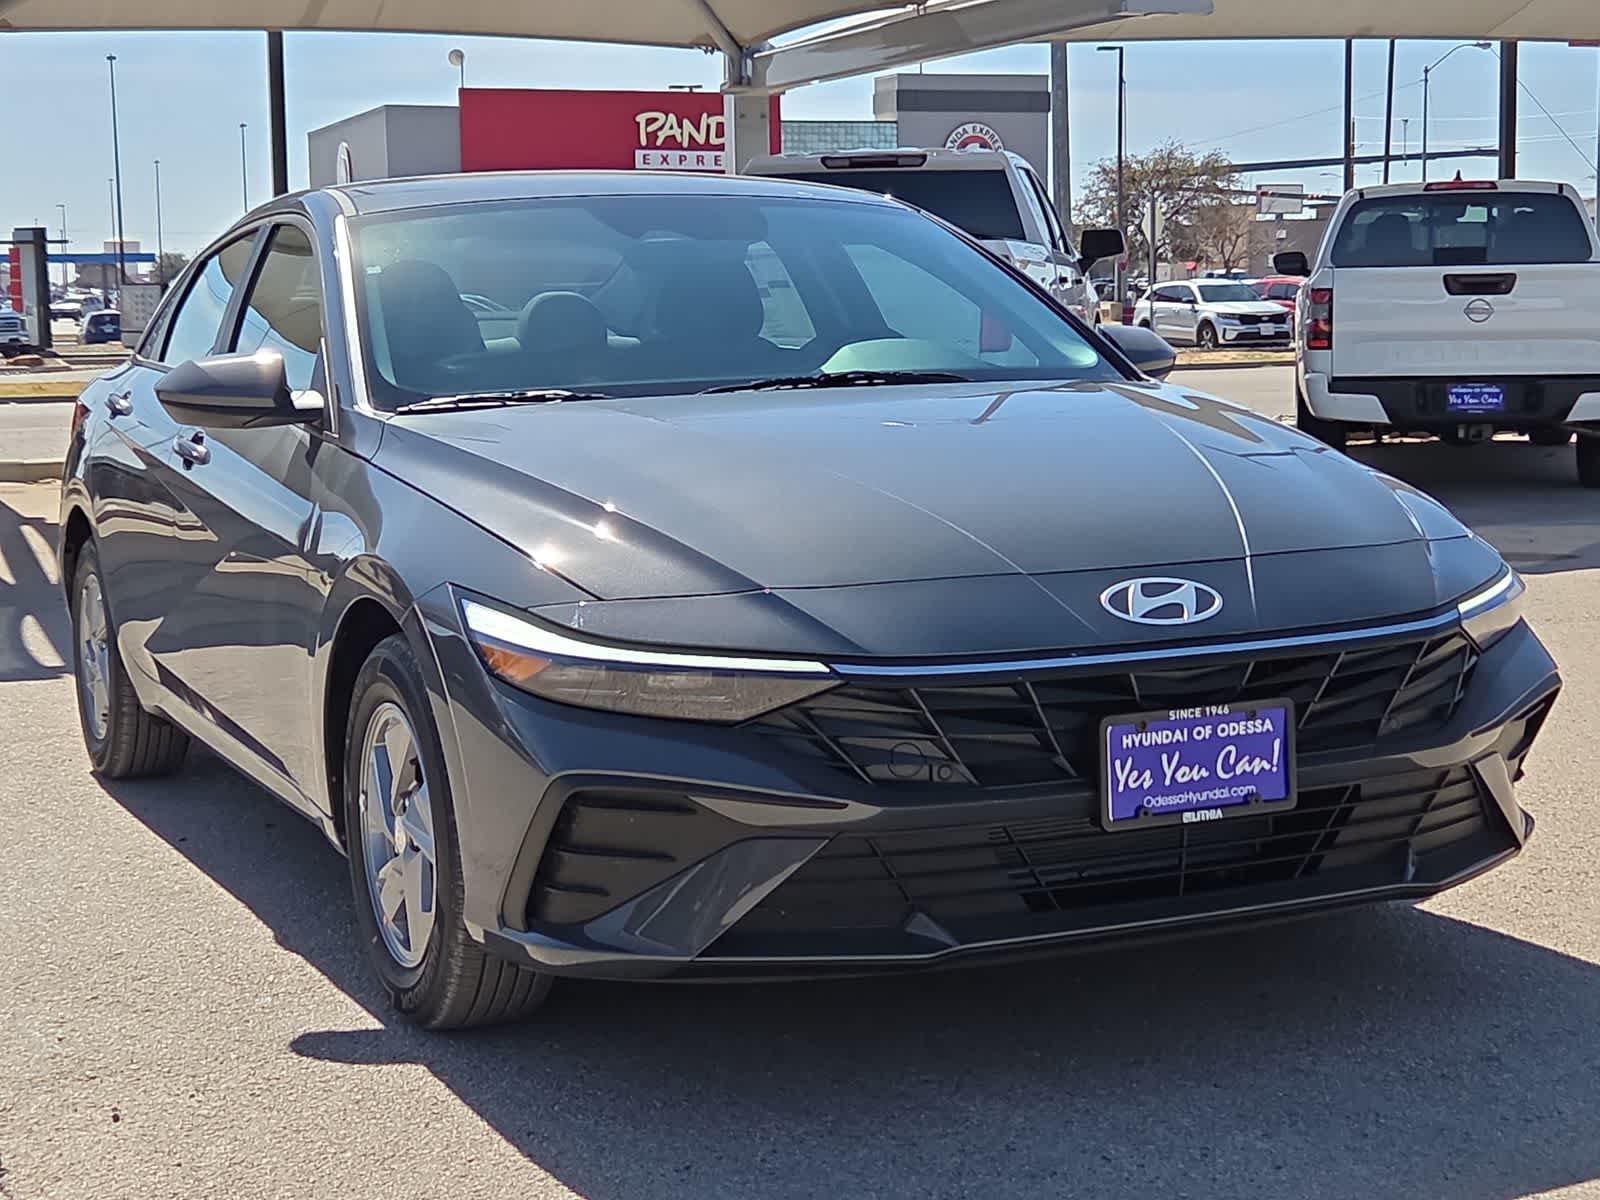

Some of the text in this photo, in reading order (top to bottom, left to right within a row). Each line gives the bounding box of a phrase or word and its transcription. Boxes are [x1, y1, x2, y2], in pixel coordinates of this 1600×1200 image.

[635, 111, 725, 148] PAND
[947, 125, 1002, 152] ANDA EXPRES
[642, 153, 723, 167] EXPRE
[1169, 707, 1202, 721] SINCE
[1122, 718, 1273, 749] HYUNDAI OF ODESSA
[1114, 738, 1280, 792] Yes You Can!
[1143, 785, 1256, 808] OdessaHyundai.com
